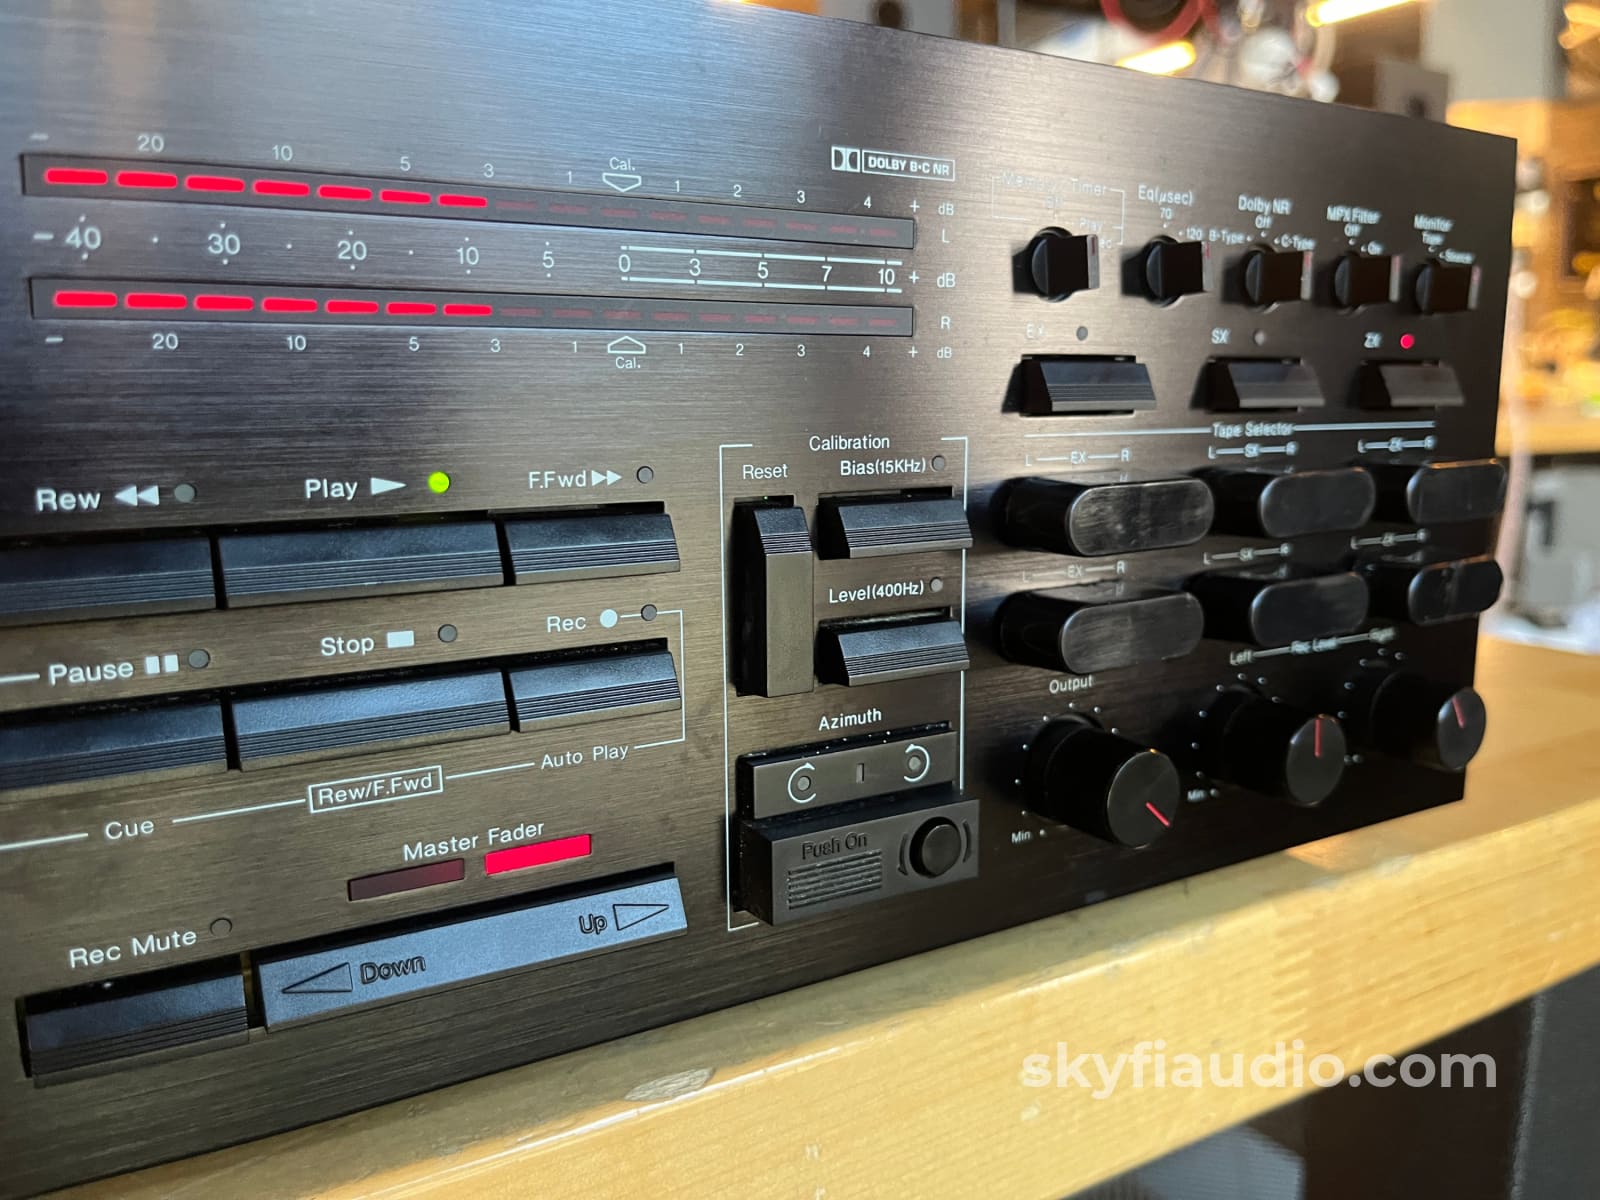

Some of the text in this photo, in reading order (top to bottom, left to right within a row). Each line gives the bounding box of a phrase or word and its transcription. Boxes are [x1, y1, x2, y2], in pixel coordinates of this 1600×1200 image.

[137, 134, 165, 153] 20
[272, 144, 294, 162] 10
[400, 156, 411, 172] 5
[483, 163, 495, 178] 3
[609, 157, 636, 172] Cal.
[868, 156, 906, 171] DOLBY
[932, 163, 950, 176] NR
[733, 184, 742, 198] 2
[796, 190, 806, 204] 3
[863, 195, 872, 209] 4
[938, 202, 954, 216] dB
[1238, 194, 1292, 215] Dolby NR
[1160, 207, 1172, 220] 70
[942, 228, 950, 243] L
[65, 227, 956, 288] 40 30 20 10 5 0 3 5 7 10 dB
[940, 316, 951, 329] R
[152, 333, 179, 351] 20
[286, 335, 306, 352] 10
[408, 337, 420, 352] 5
[490, 339, 501, 354] 3
[1211, 328, 1231, 344] SX
[735, 344, 745, 358] 2
[796, 345, 806, 358] 3
[862, 346, 872, 359] 4
[937, 346, 953, 359] dB
[614, 356, 642, 371] Cal.
[1213, 421, 1293, 439] Tape Selector
[808, 434, 891, 452] Calibration
[1071, 451, 1087, 464] EX
[1121, 448, 1130, 462] R
[742, 463, 789, 480] Reset
[839, 459, 927, 477] Bias(15KHz)
[304, 478, 359, 500] Play
[528, 470, 587, 489] F.Fwd
[36, 486, 101, 512] Rew
[1067, 565, 1083, 578] EX
[1116, 561, 1125, 574] R
[829, 581, 925, 603] Level(400Hz)
[547, 616, 587, 633] Rec
[320, 636, 375, 656] Stop
[49, 661, 134, 686] Pause
[1049, 675, 1094, 694] Output
[818, 708, 883, 732] Azimuth
[540, 745, 629, 770] Auto Play
[318, 773, 433, 806] Rew/F.Fwd
[105, 819, 155, 840] Cue
[1011, 831, 1031, 843] Min
[403, 822, 546, 862] Master Fader
[802, 832, 868, 860] Push On
[579, 913, 608, 935] Up
[69, 929, 198, 970] Rec Mute
[360, 956, 426, 985] Down
